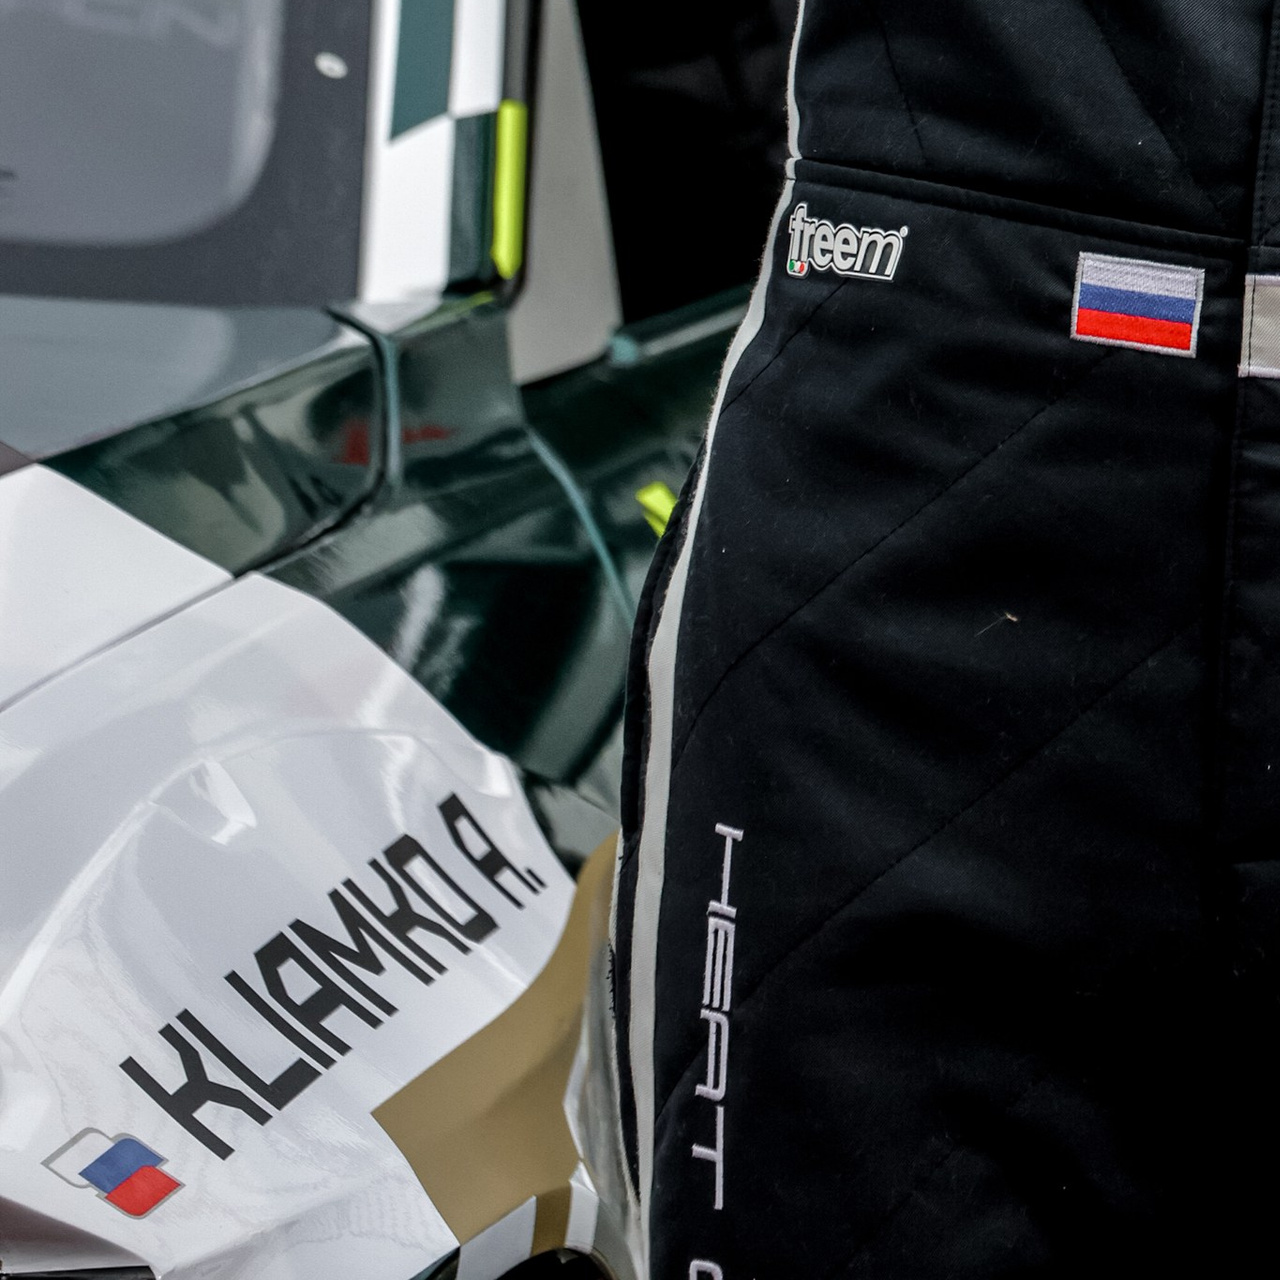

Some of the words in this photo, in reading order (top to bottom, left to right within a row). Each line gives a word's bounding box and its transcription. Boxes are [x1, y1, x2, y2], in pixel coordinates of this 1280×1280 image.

[788, 204, 903, 278] freem
[118, 833, 500, 1161] KLIAMKO
[437, 792, 548, 910] A.
[691, 822, 745, 1210] HEAT
